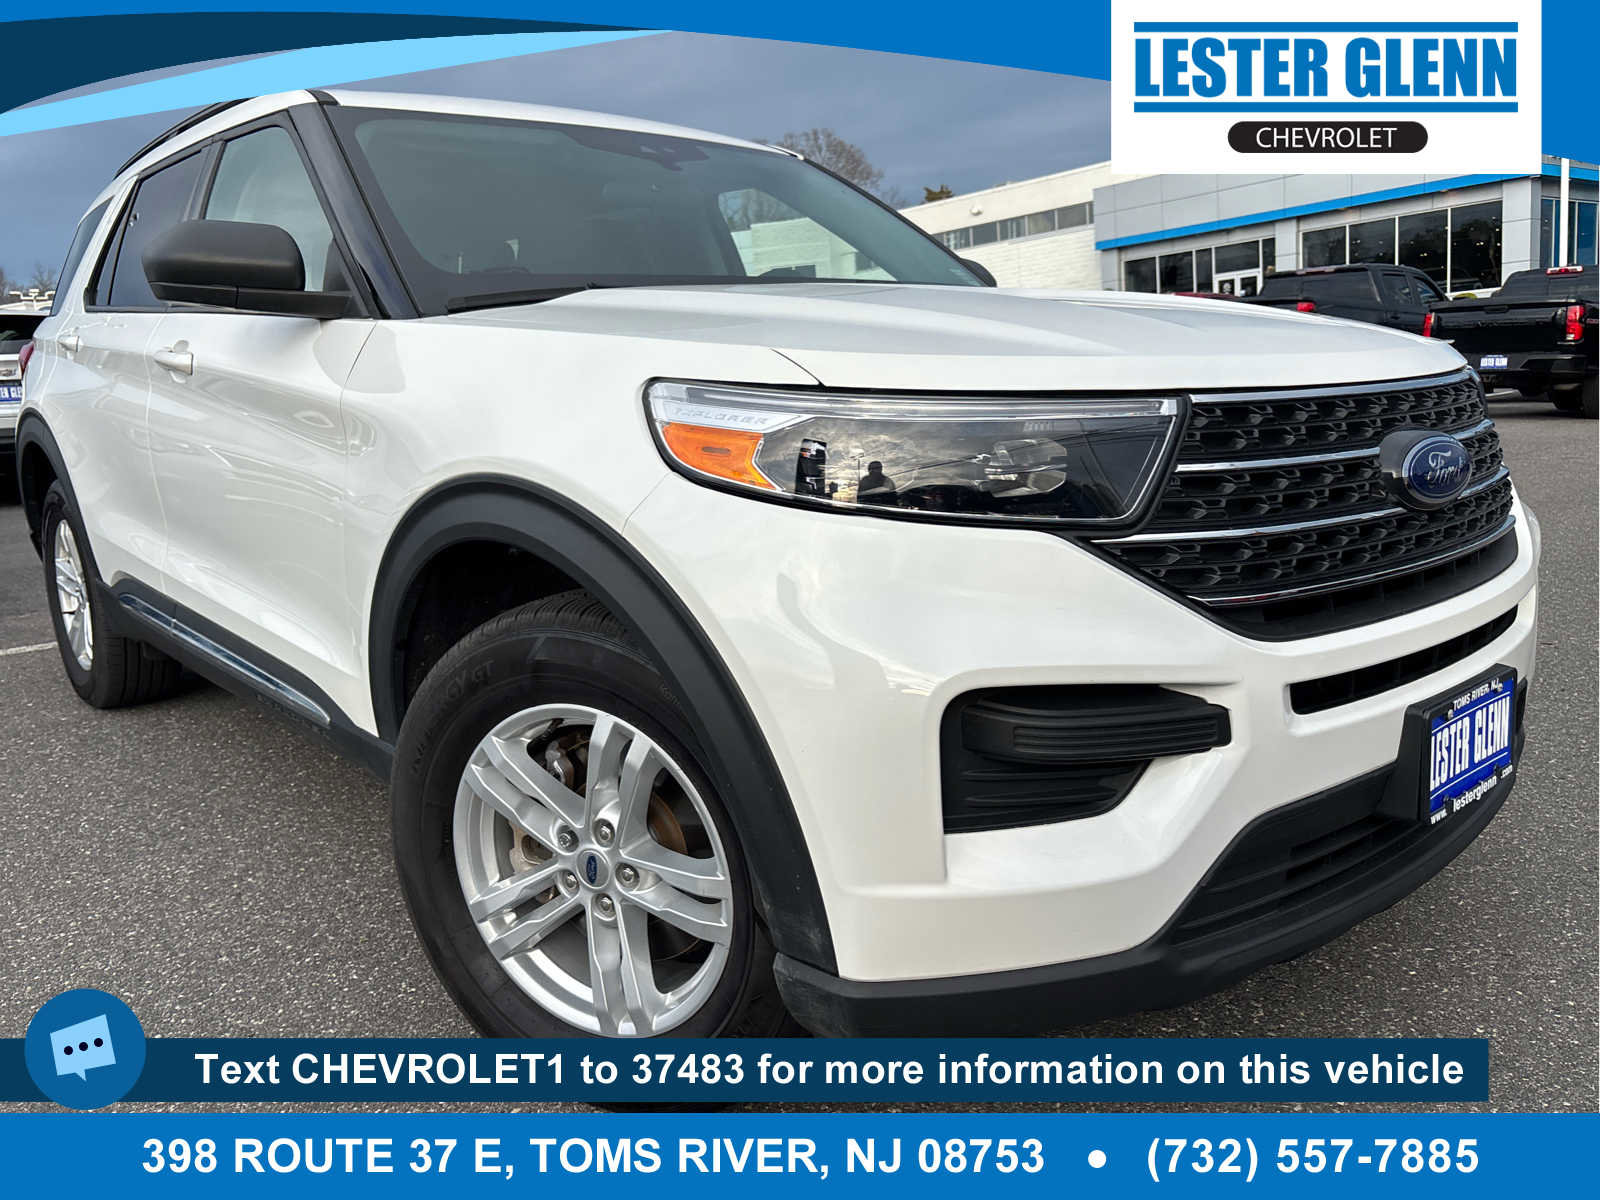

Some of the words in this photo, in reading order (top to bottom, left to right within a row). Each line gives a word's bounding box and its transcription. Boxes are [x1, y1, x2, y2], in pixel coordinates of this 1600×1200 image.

[1453, 693, 1471, 711] TOMS
[1430, 716, 1471, 792] LESTER
[1473, 696, 1511, 764] GLENN
[1453, 775, 1498, 812] lesterglenn
